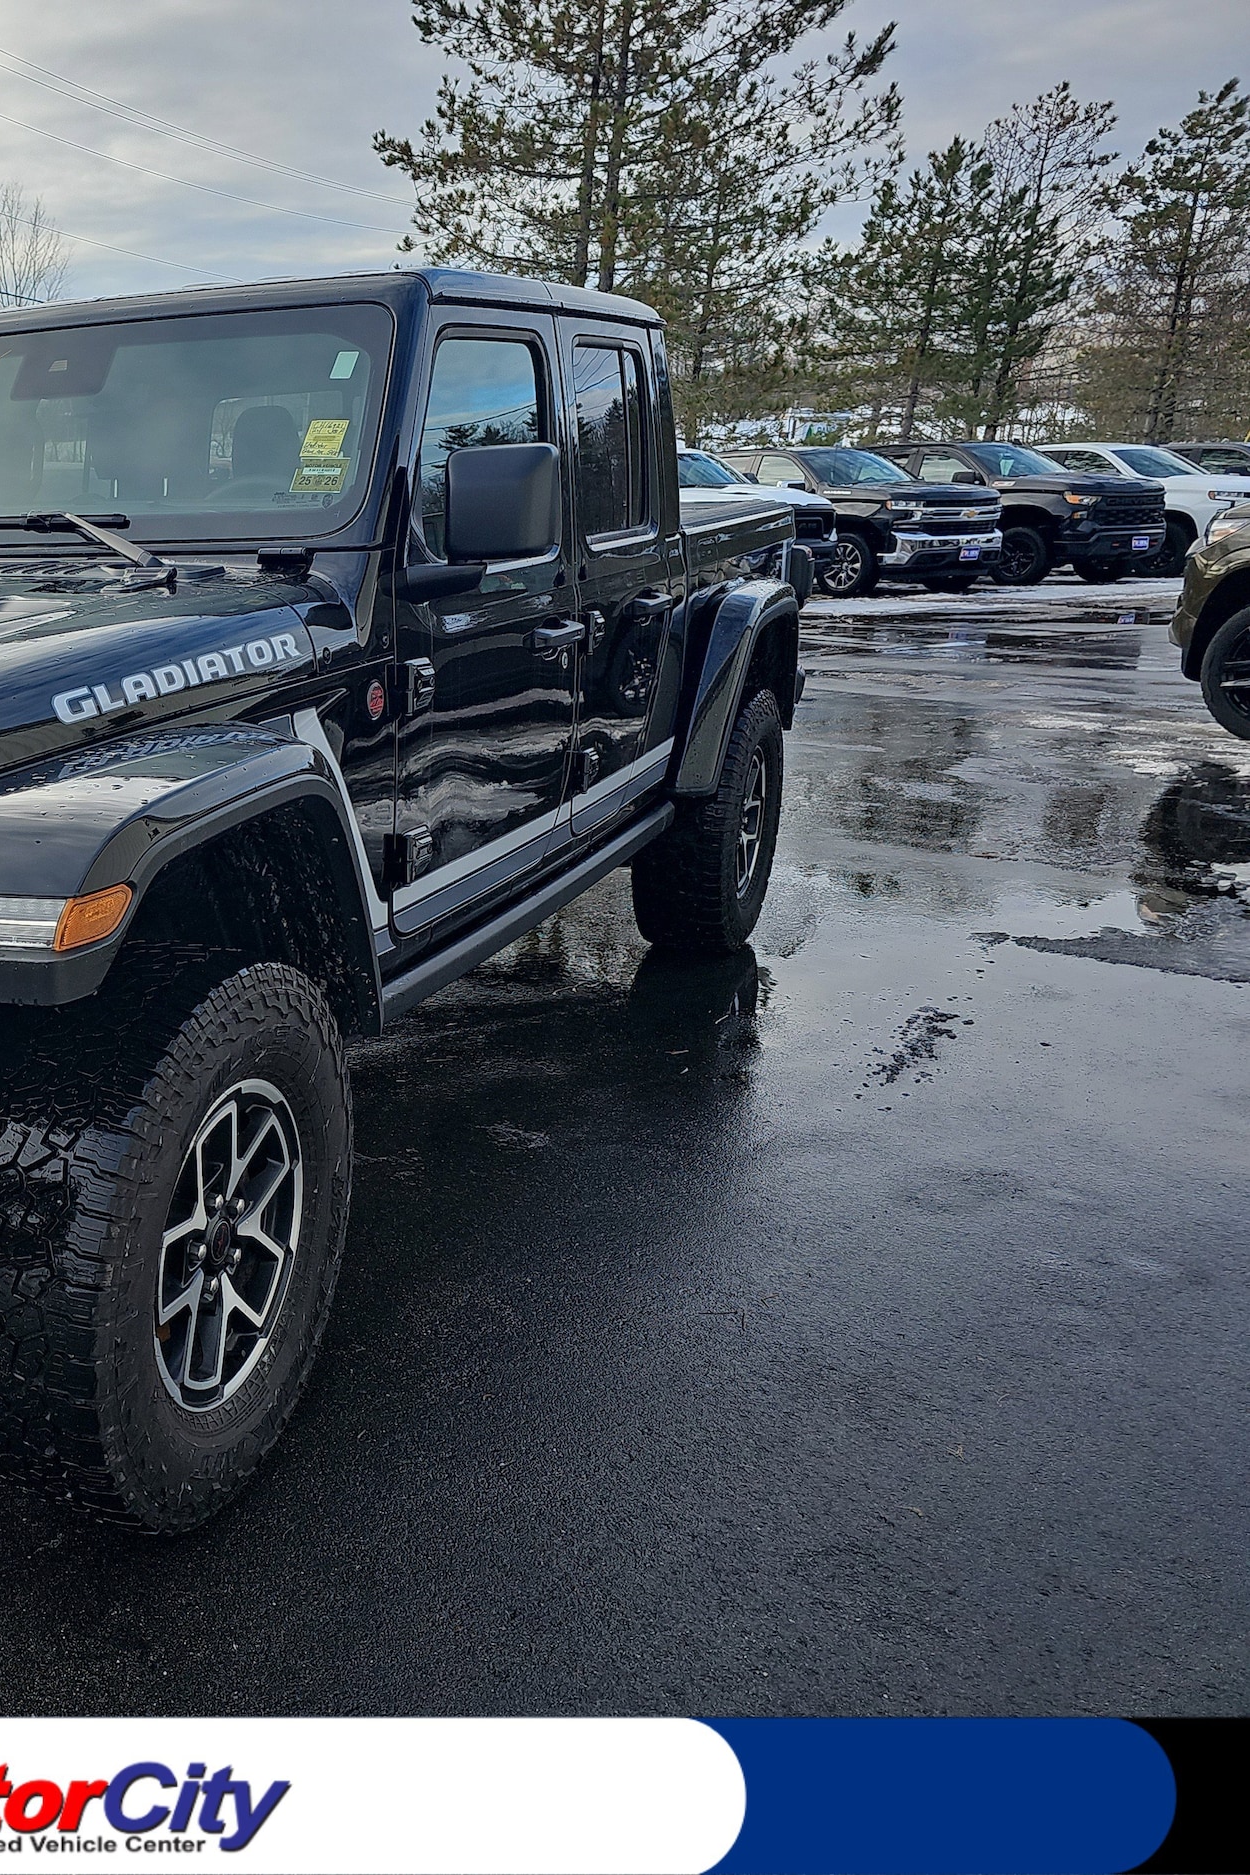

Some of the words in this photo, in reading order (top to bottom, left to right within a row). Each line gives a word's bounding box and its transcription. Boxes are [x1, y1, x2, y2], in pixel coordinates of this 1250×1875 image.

[298, 476, 312, 486] 25
[324, 476, 338, 486] 26
[51, 632, 302, 726] GLADIATOR
